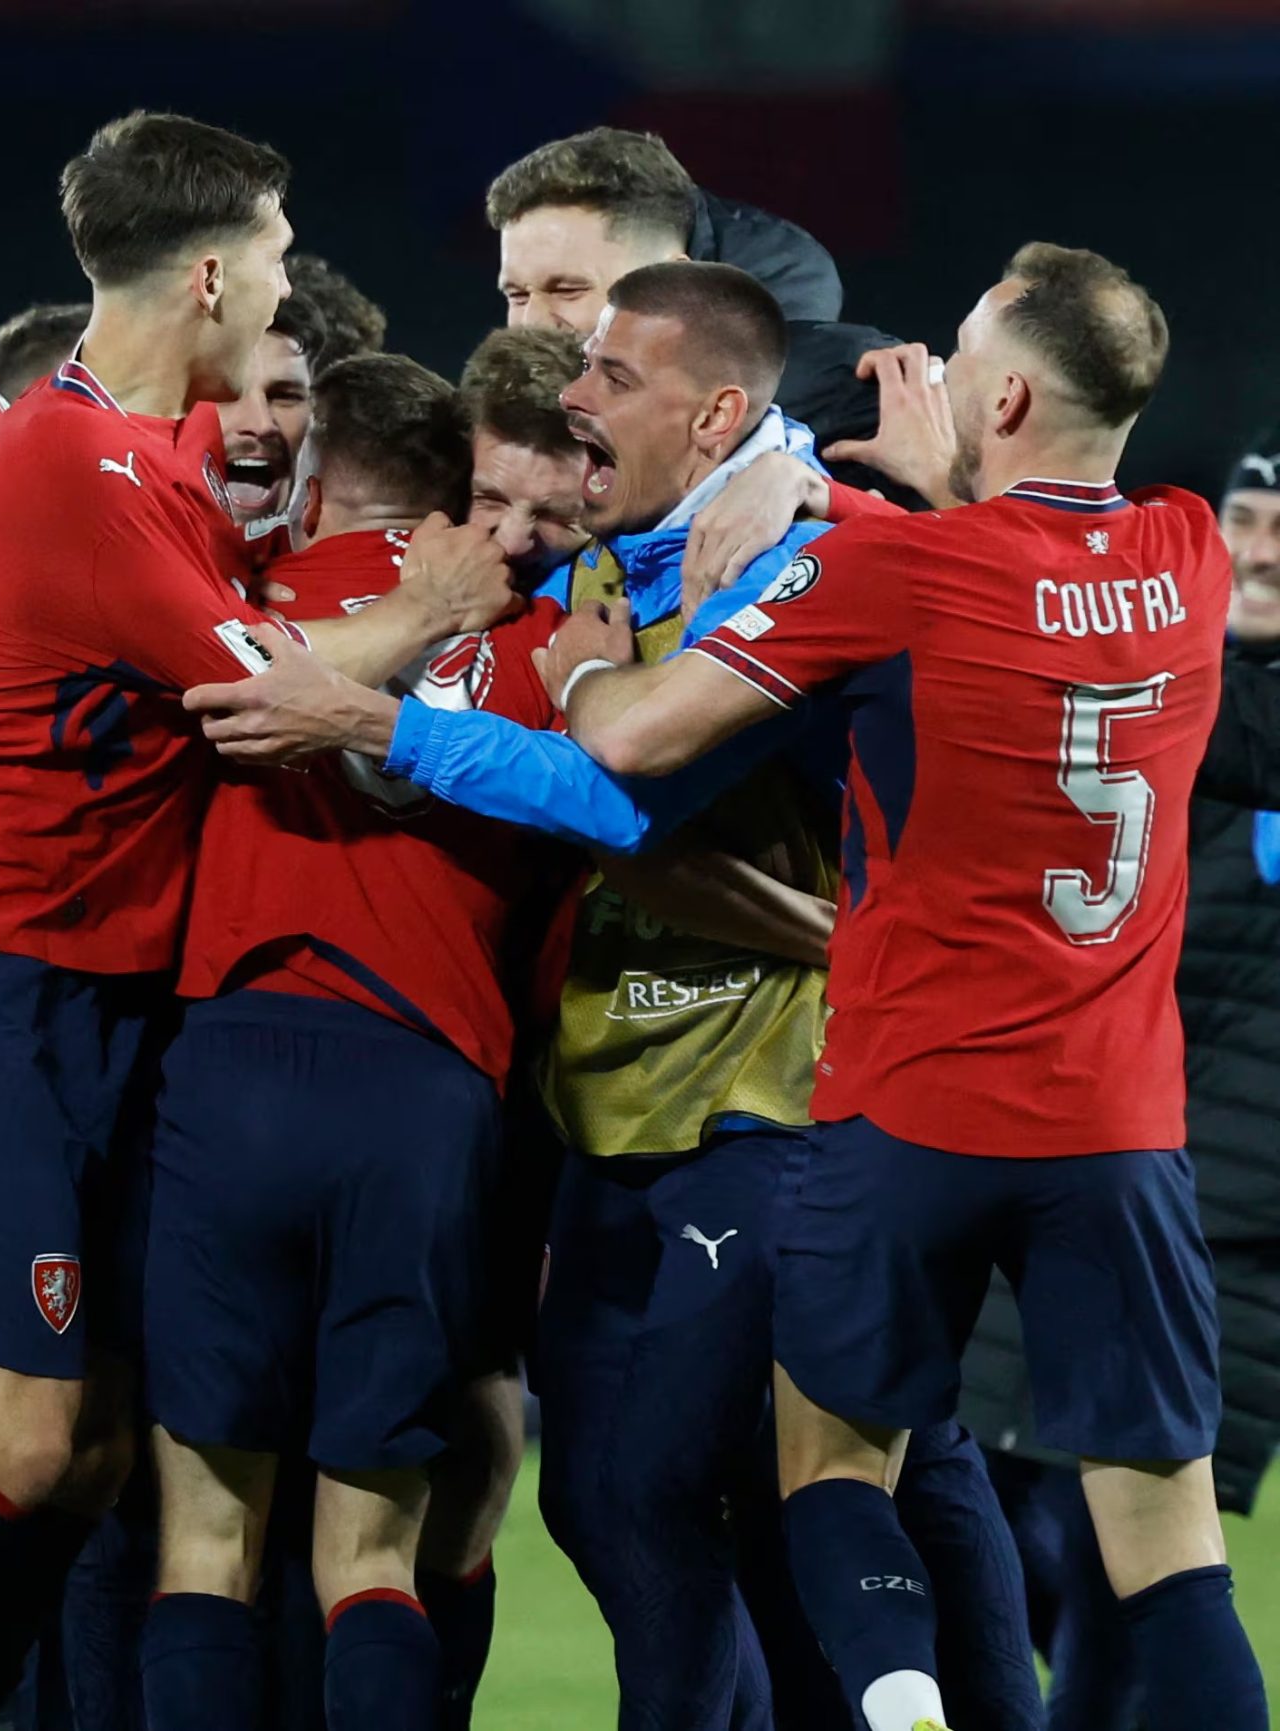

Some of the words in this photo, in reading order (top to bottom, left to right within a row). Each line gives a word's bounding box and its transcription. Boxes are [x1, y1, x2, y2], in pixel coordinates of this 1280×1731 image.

[1035, 570, 1187, 638] COUFAL
[1042, 671, 1176, 945] 5
[860, 1575, 926, 1597] CZE
